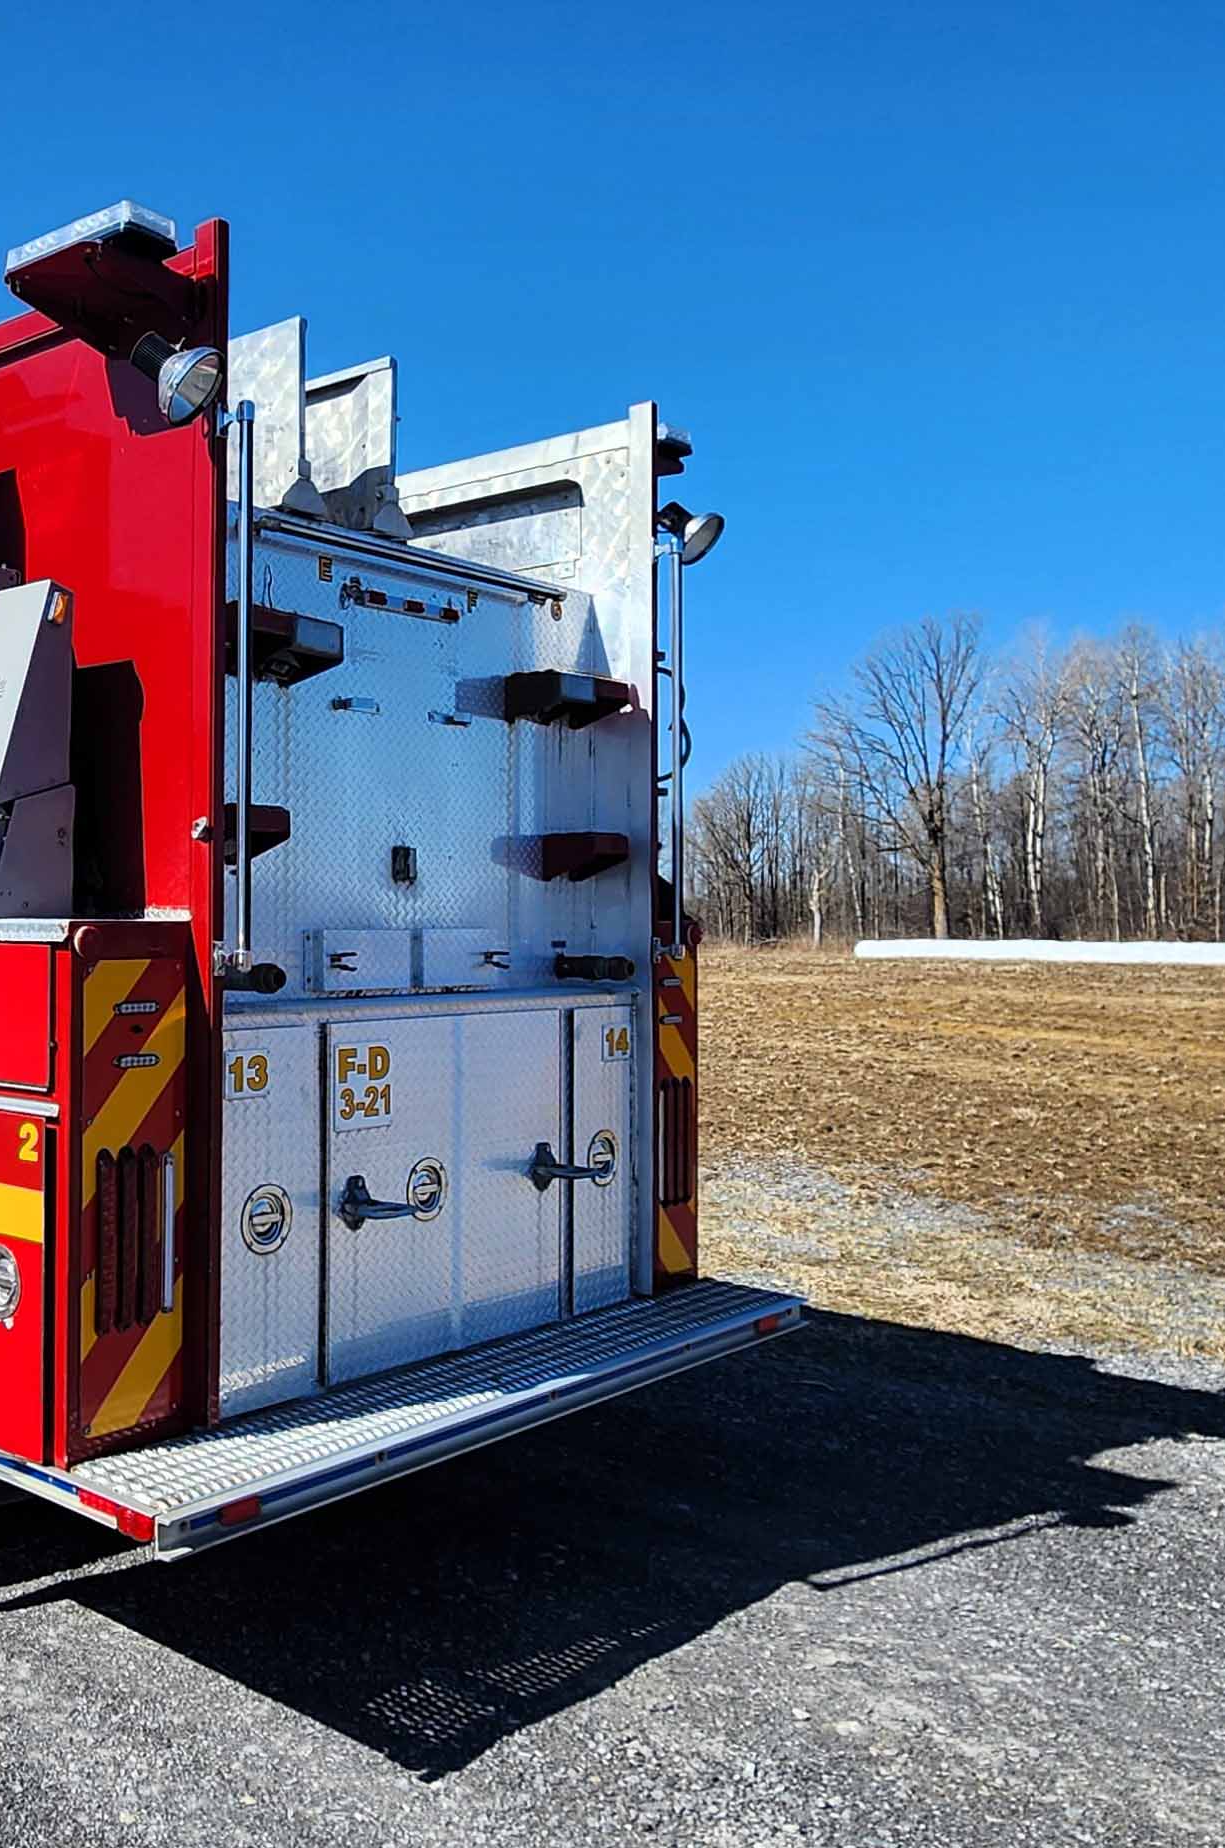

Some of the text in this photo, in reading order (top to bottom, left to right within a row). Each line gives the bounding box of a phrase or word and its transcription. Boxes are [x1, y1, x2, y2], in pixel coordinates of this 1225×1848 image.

[319, 555, 333, 583] E
[467, 590, 479, 614] F
[605, 1027, 630, 1056] 14
[228, 1055, 269, 1093] 13
[338, 1046, 391, 1084] F-D
[339, 1084, 391, 1121] 3-21
[18, 1121, 39, 1162] 2
